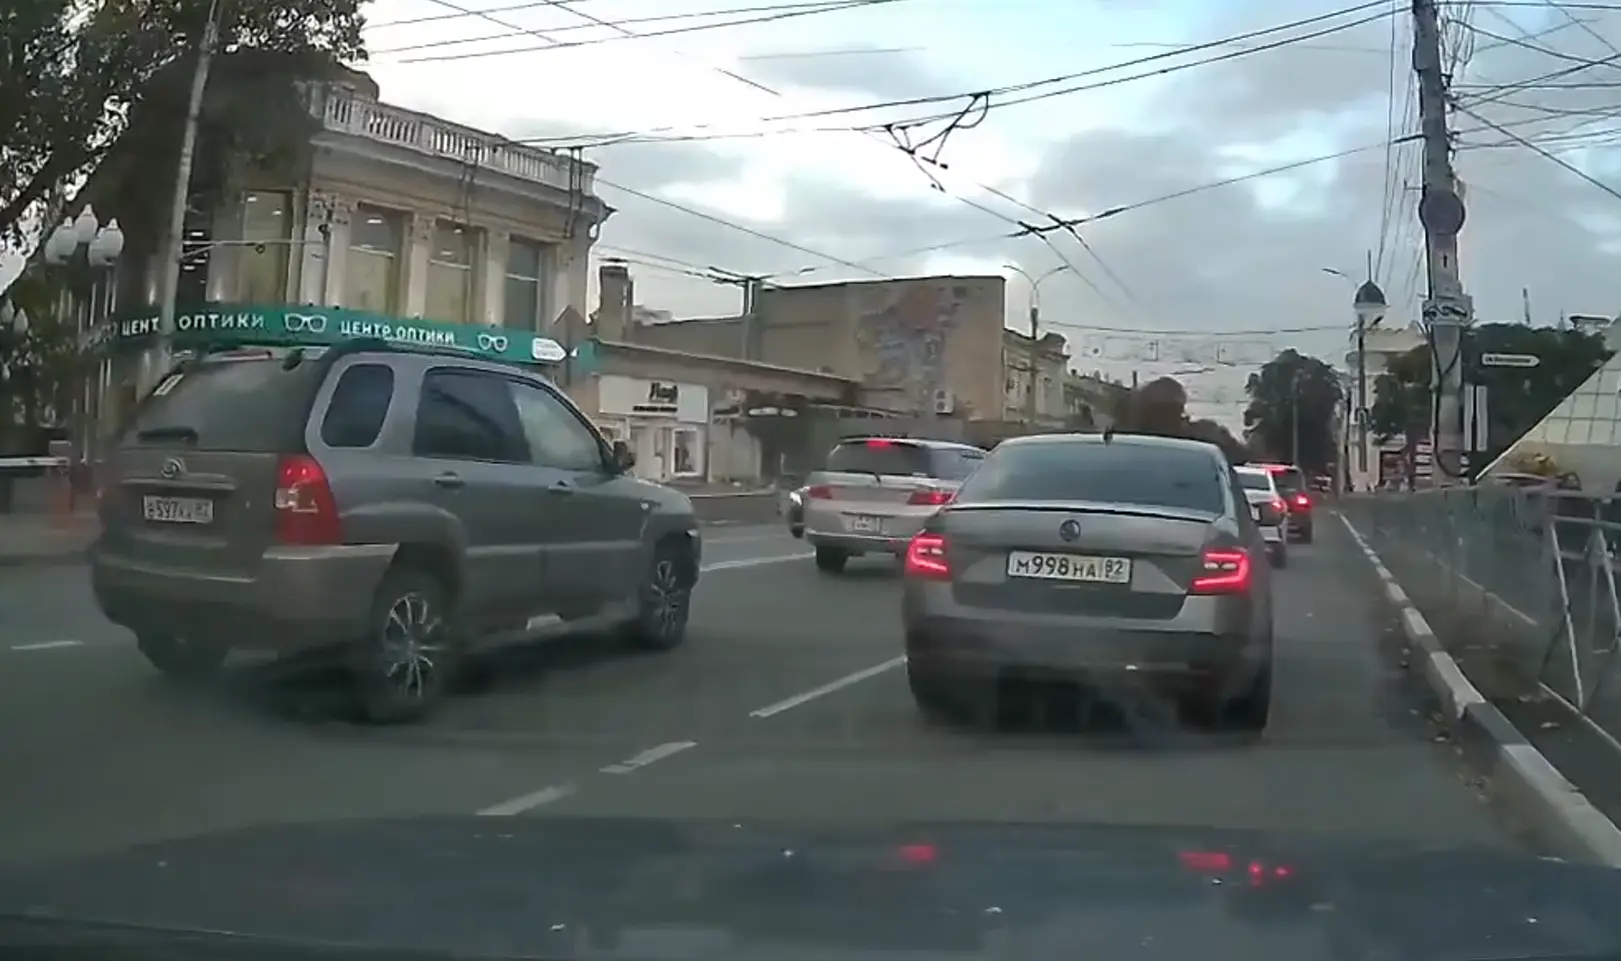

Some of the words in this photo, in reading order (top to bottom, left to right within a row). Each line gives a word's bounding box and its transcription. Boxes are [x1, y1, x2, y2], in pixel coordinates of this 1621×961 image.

[121, 317, 160, 337] ЦЕНТ
[178, 313, 265, 330] ОПТИКИ
[340, 320, 391, 338] ЦЕНТР
[395, 325, 456, 344] ОПТИКИ
